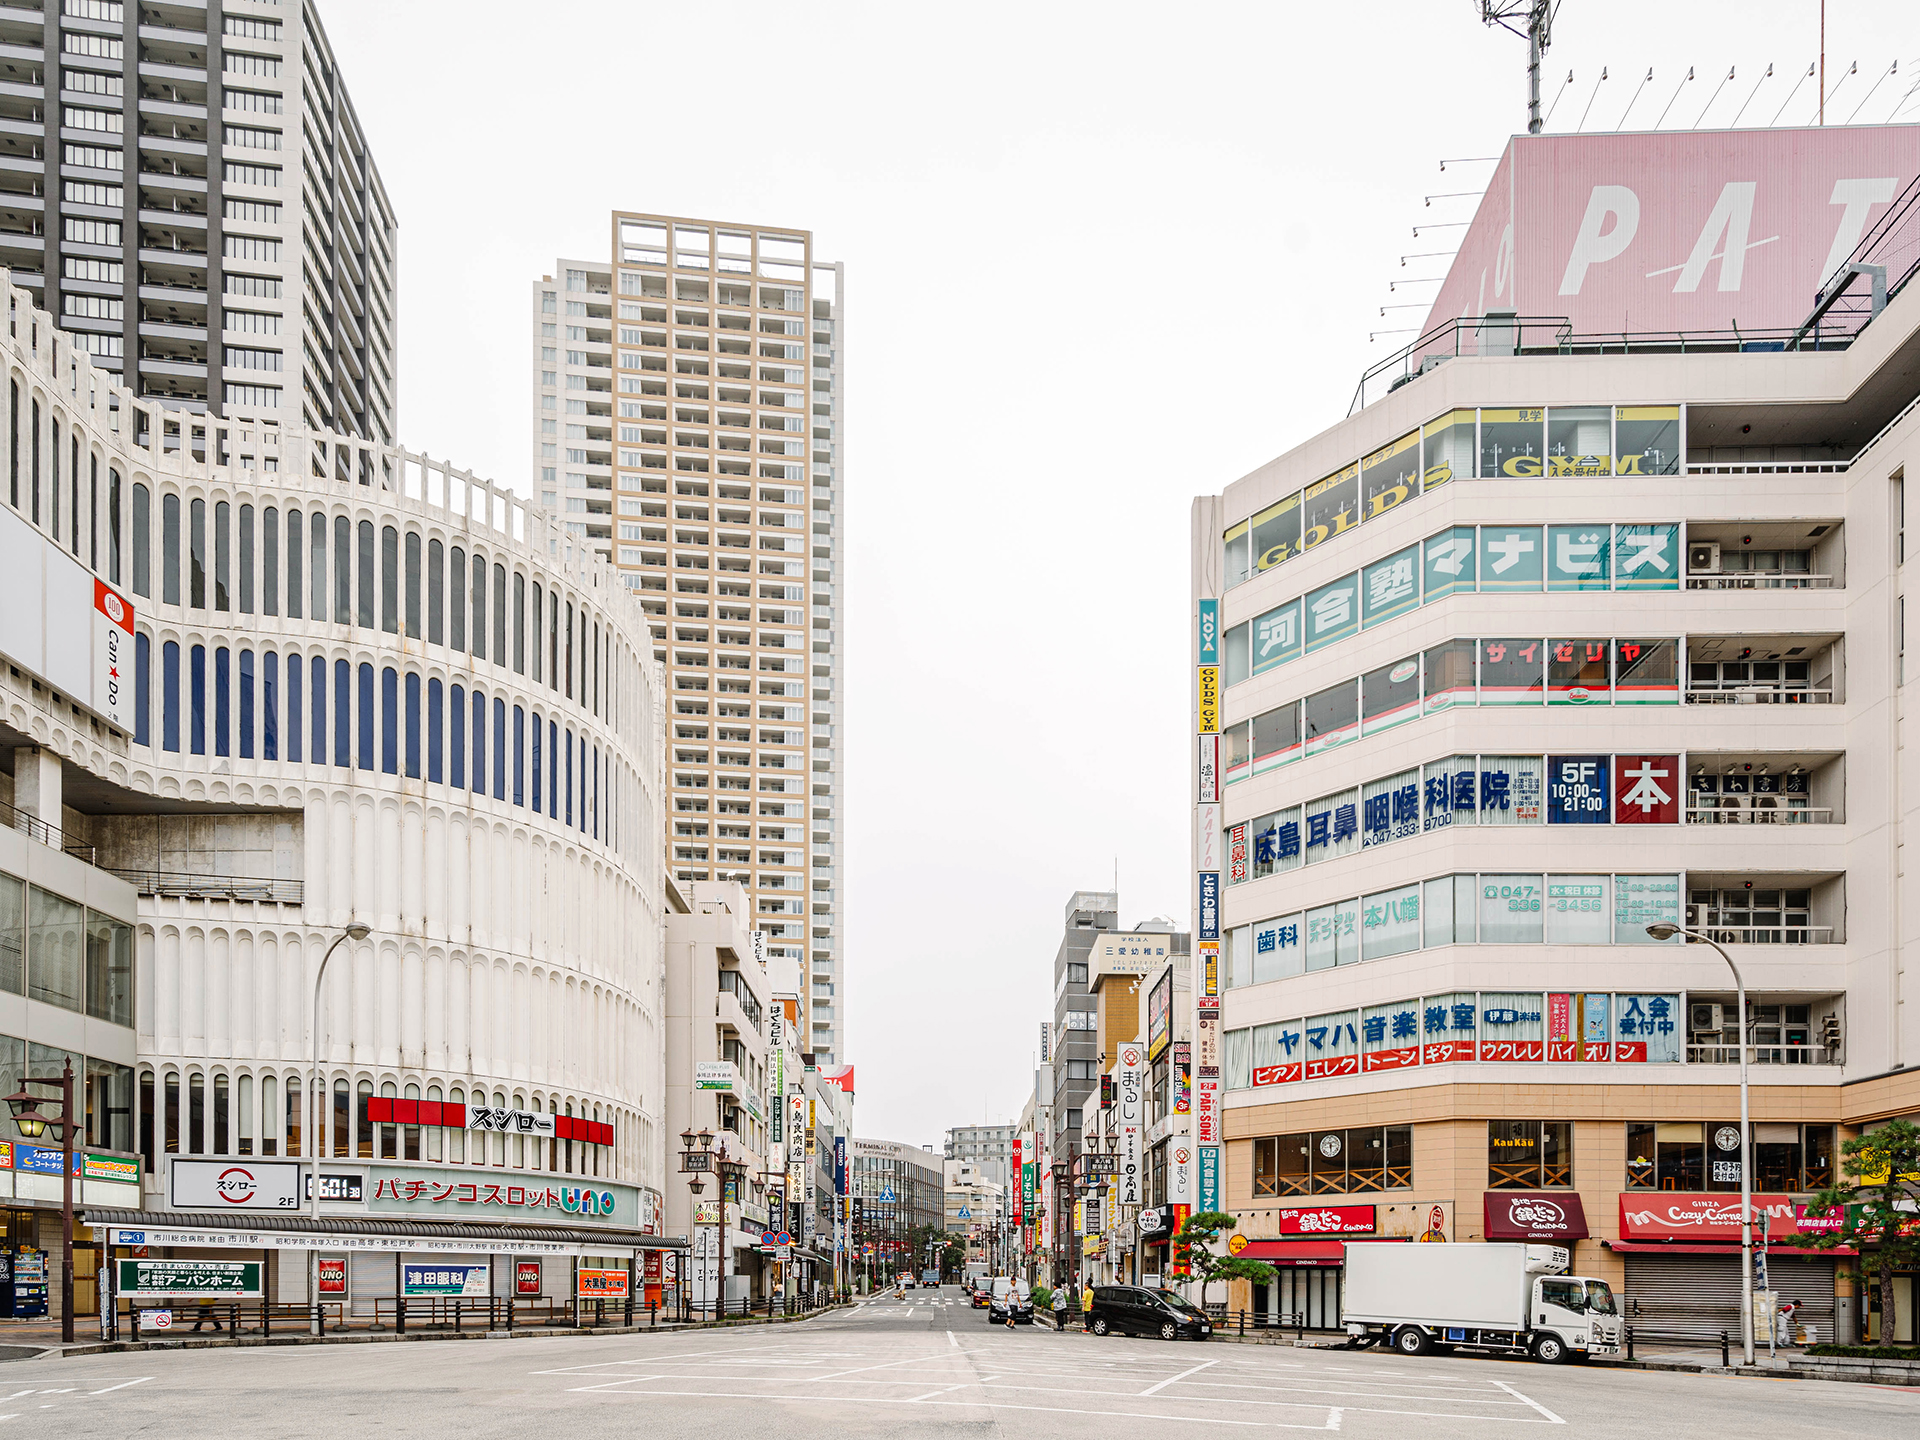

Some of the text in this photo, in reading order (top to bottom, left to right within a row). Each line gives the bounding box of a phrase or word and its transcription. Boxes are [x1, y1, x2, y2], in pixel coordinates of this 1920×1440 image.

[1518, 409, 1542, 421] 見学
[1550, 465, 1610, 478] 入会受付中
[108, 597, 121, 616] 100
[1202, 612, 1215, 652] NOVA
[1486, 642, 1641, 663] サイゼリヤ
[108, 629, 119, 707] Can Do
[1202, 709, 1215, 731] GYM
[1561, 762, 1596, 783] 5F
[1202, 790, 1214, 799] 6F
[1621, 761, 1672, 813] 本
[1563, 797, 1603, 812] 21:00
[1204, 806, 1214, 868] PATIO
[1372, 812, 1452, 846] 047-333-9700
[1230, 825, 1246, 883] 耳鼻科
[1550, 886, 1601, 896] 水・祝日 休診
[1202, 875, 1216, 930] ときわ書房
[1364, 894, 1419, 929] 本八幡
[1508, 899, 1541, 912] 336
[1309, 910, 1356, 932] デンタル
[1256, 923, 1299, 954] 歯科
[1309, 923, 1355, 943] オフィス
[1105, 946, 1165, 956] 三愛幼稚園
[1488, 1010, 1541, 1022] 伊藤楽器
[1624, 996, 1671, 1018] 入会
[1277, 1003, 1476, 1056] ヤマハ音楽教室
[1619, 1018, 1675, 1036] 受付中
[1174, 1043, 1191, 1053] SHOT
[1176, 1054, 1191, 1063] BAR
[1256, 1043, 1635, 1085] ピアノ エレクトーン ギター ウクレレ バイオリン
[1122, 1070, 1138, 1120] まるし
[1178, 1102, 1189, 1110] 3F
[468, 1106, 554, 1132] スシロー
[215, 1178, 258, 1192] スシロー
[374, 1176, 561, 1209] パチンコスロット
[278, 1197, 295, 1206] 2F
[1691, 1200, 1721, 1208] GINZA
[1298, 1208, 1342, 1231] 銀だこ
[1514, 1204, 1557, 1223] 銀だこ
[1668, 1206, 1743, 1225] Cozy Corne
[153, 1234, 205, 1243] 市川総合病院
[209, 1235, 225, 1244] 経由
[228, 1234, 259, 1243] 市川駅
[165, 1275, 244, 1286] アーバンホーム
[320, 1270, 345, 1281] UNO
[408, 1271, 464, 1285] 津田眼科
[518, 1272, 539, 1282] UNO
[584, 1276, 607, 1289] 大黒屋
